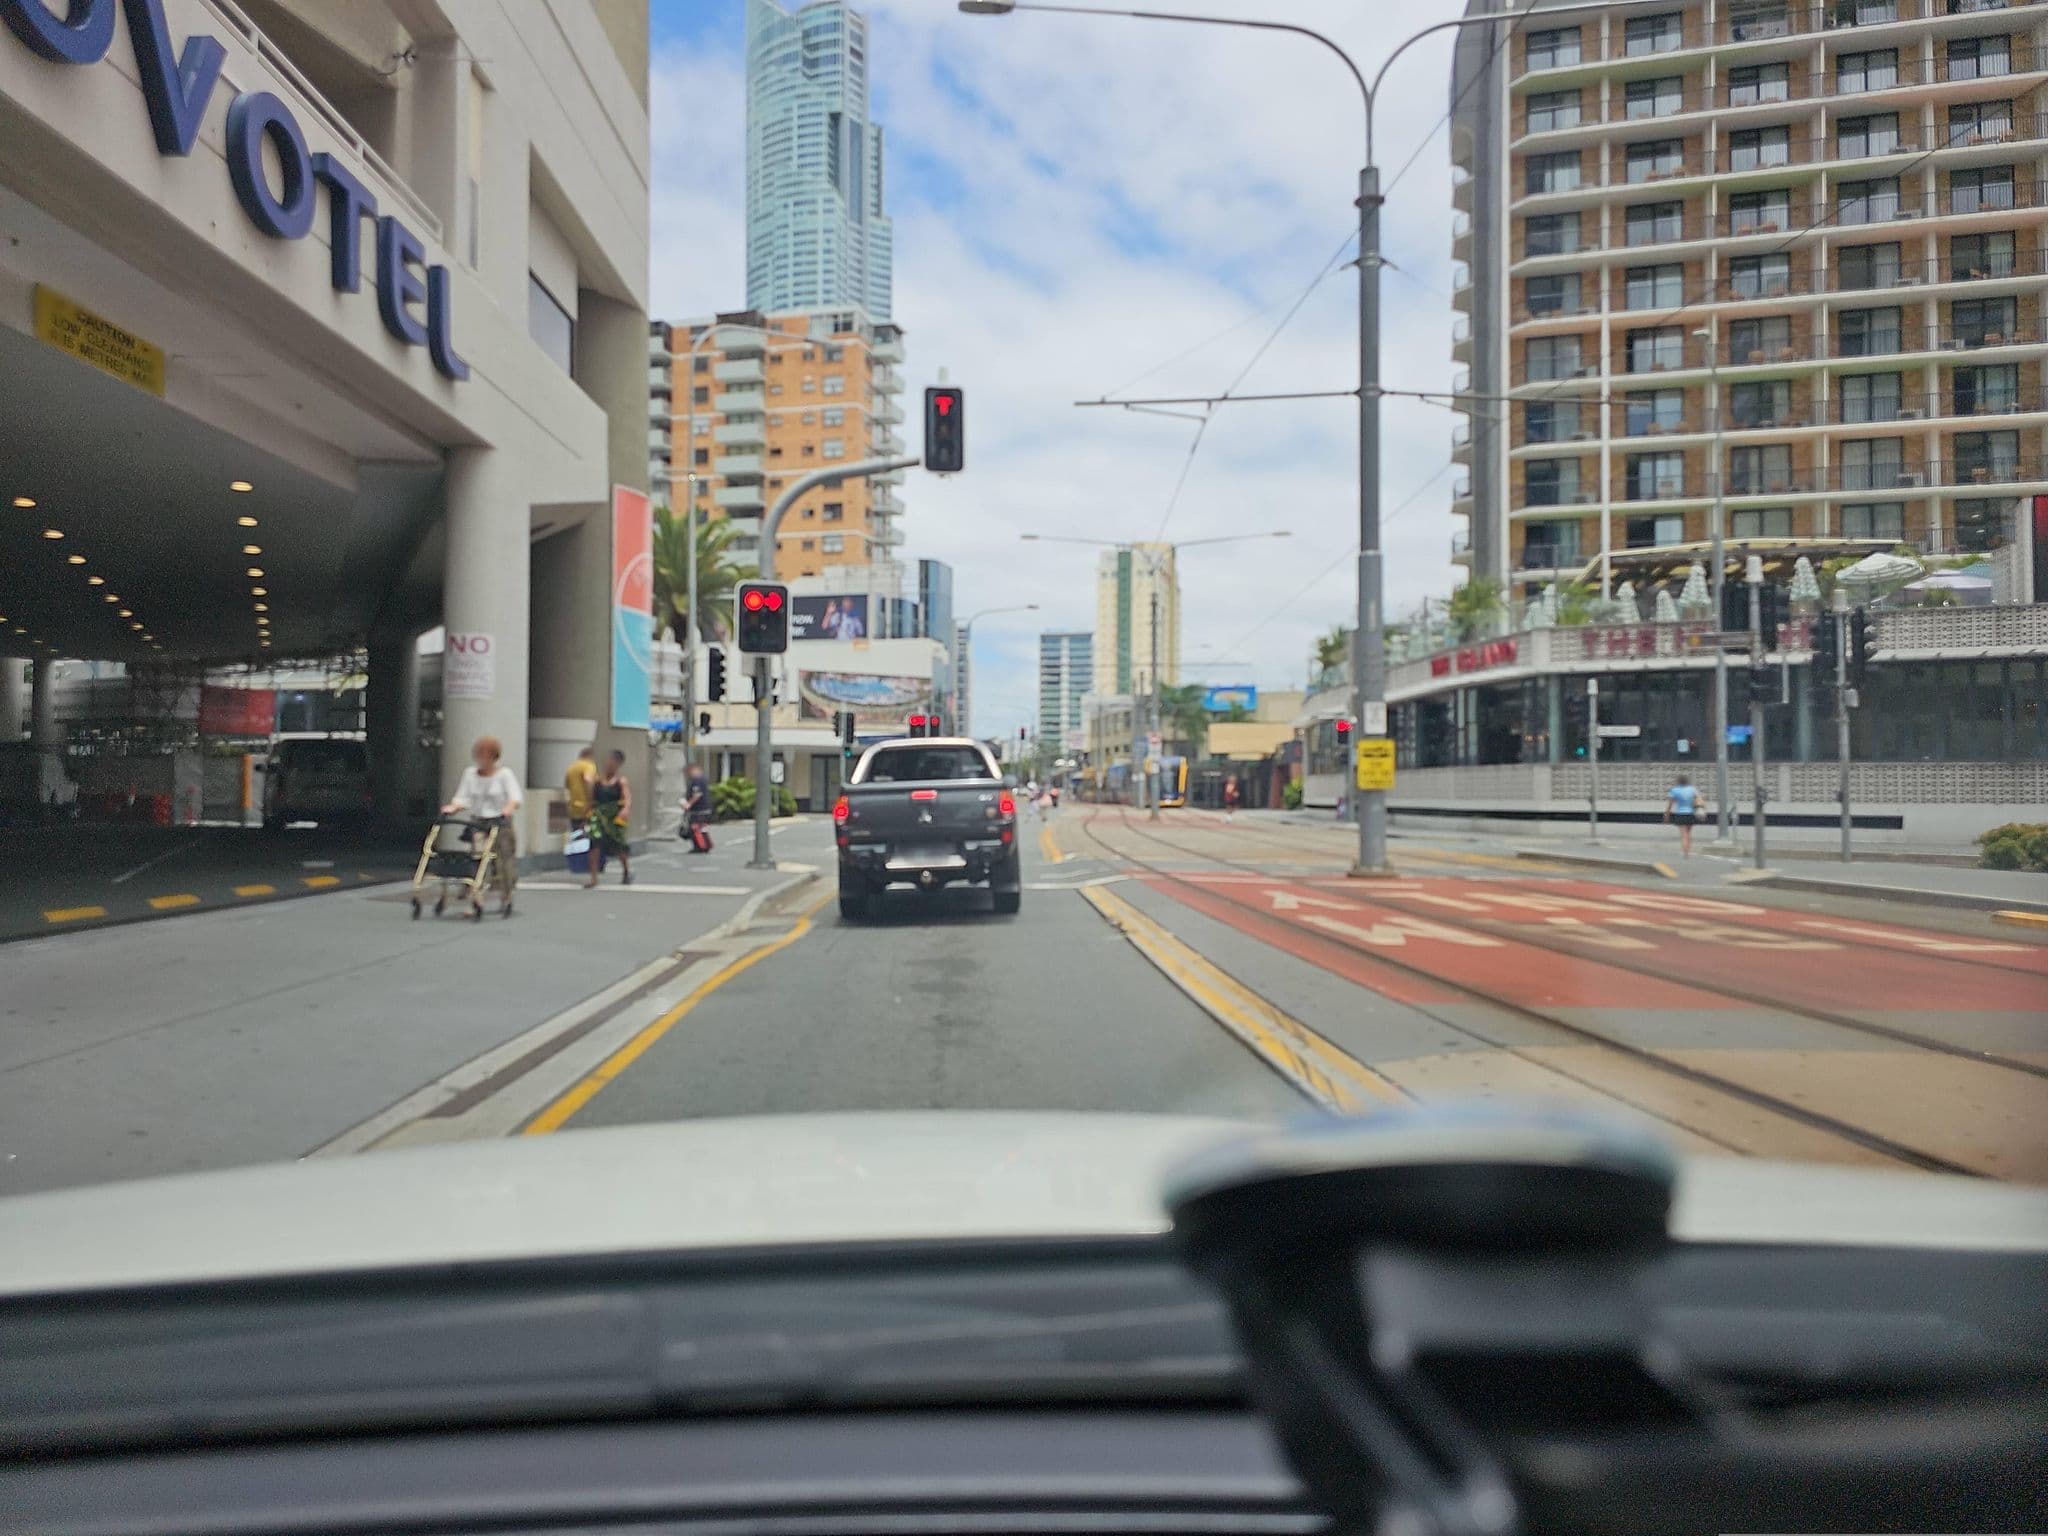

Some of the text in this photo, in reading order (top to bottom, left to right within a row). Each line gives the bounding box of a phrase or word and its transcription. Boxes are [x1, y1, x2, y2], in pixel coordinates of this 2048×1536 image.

[51, 312, 81, 335] LOW
[77, 310, 135, 349] CAUTION
[448, 635, 490, 654] NO
[1582, 629, 1656, 657] THE
